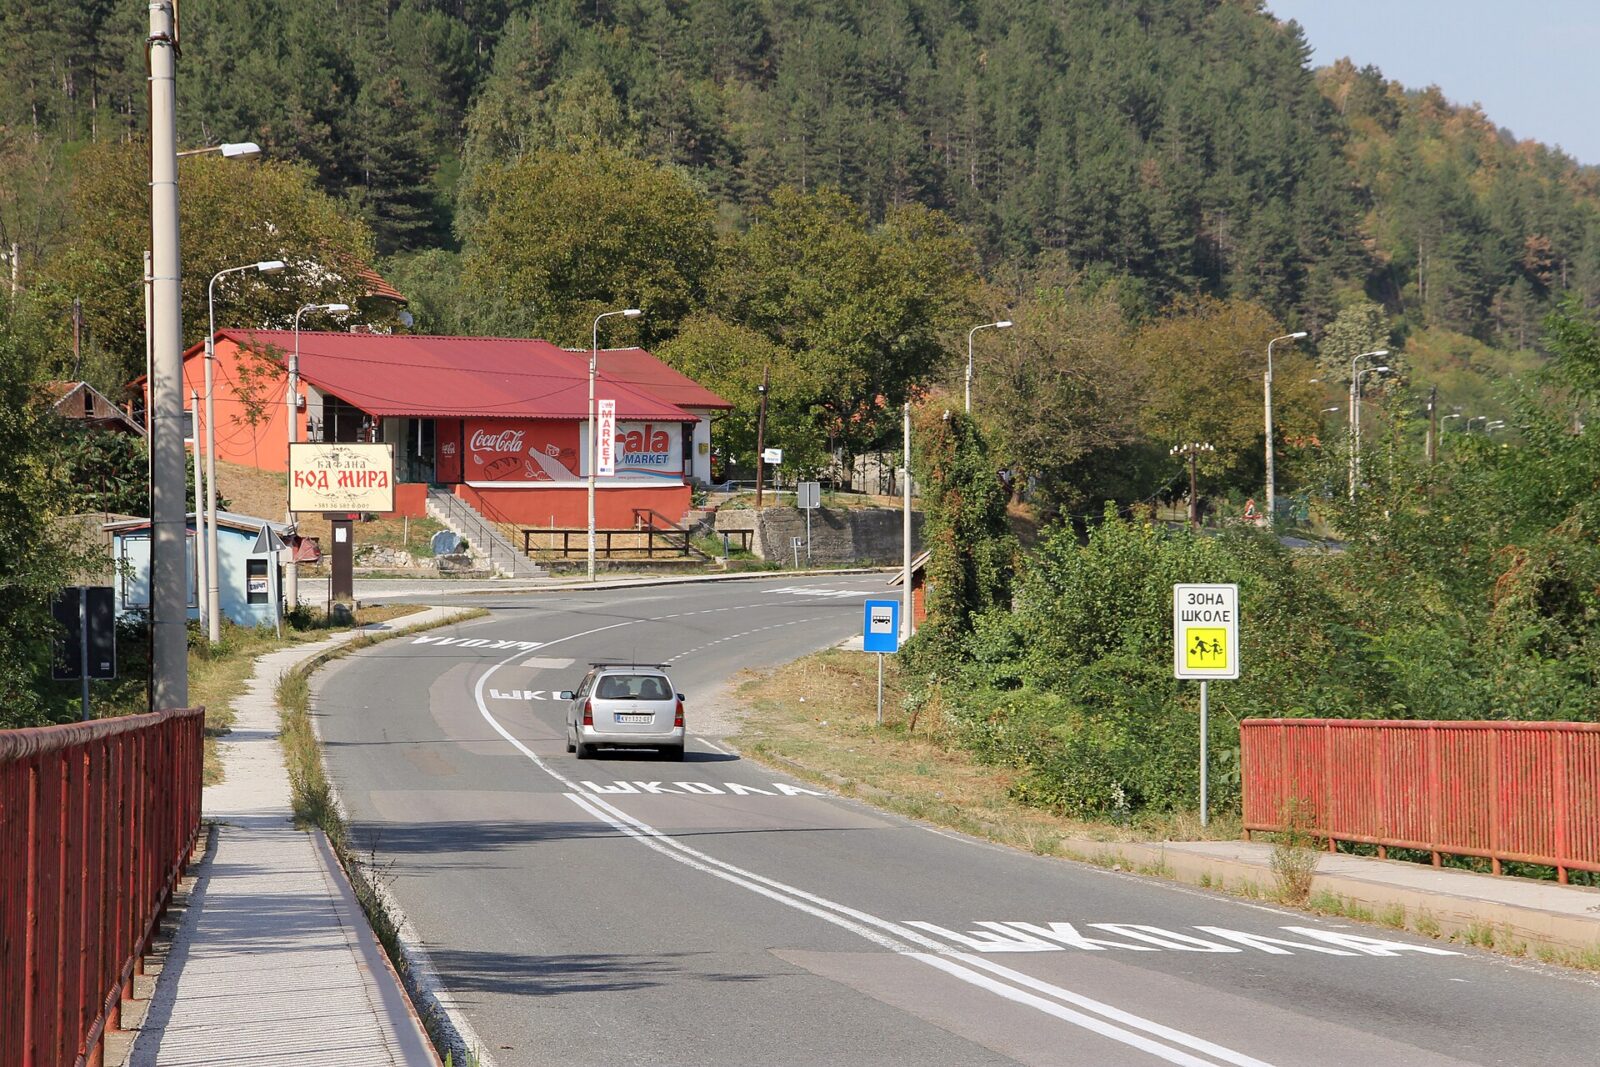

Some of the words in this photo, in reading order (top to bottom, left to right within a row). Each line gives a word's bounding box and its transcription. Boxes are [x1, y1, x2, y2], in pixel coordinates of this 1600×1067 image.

[602, 409, 612, 465] MARKET
[624, 454, 669, 465] MARKET
[294, 470, 329, 490] КОД
[337, 470, 389, 489] МИРА
[1187, 593, 1224, 605] ЗОНА
[1181, 610, 1231, 622] ШКОЛЕ
[580, 781, 826, 796] ШКОЛА
[901, 920, 1465, 956] ШКОЛА
